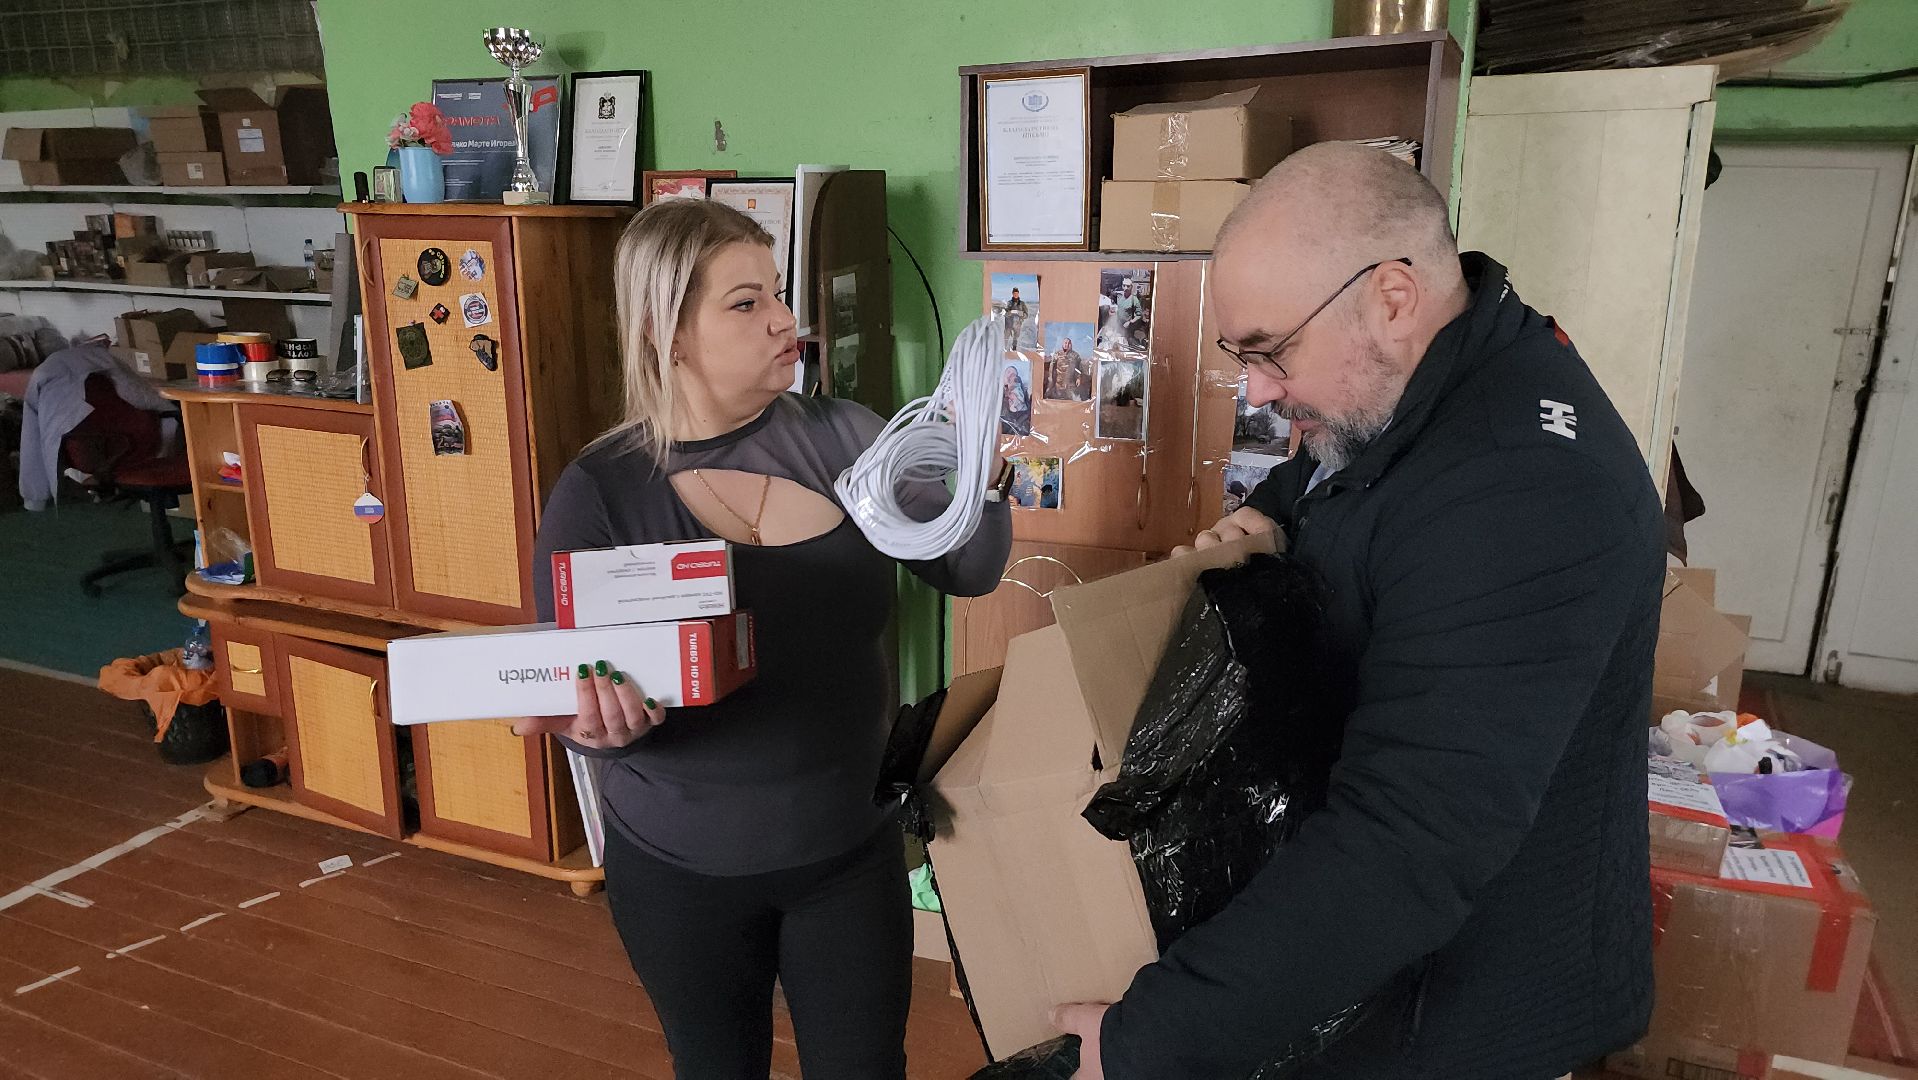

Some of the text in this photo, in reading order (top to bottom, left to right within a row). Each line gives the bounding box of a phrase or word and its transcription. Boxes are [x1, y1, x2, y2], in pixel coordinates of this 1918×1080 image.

[446, 115, 500, 126] РАМОТА
[690, 560, 721, 569] TURBO
[559, 562, 569, 606] TURBO HD
[689, 632, 701, 699] TURBO HD DVR
[498, 666, 570, 684] HiWatch
